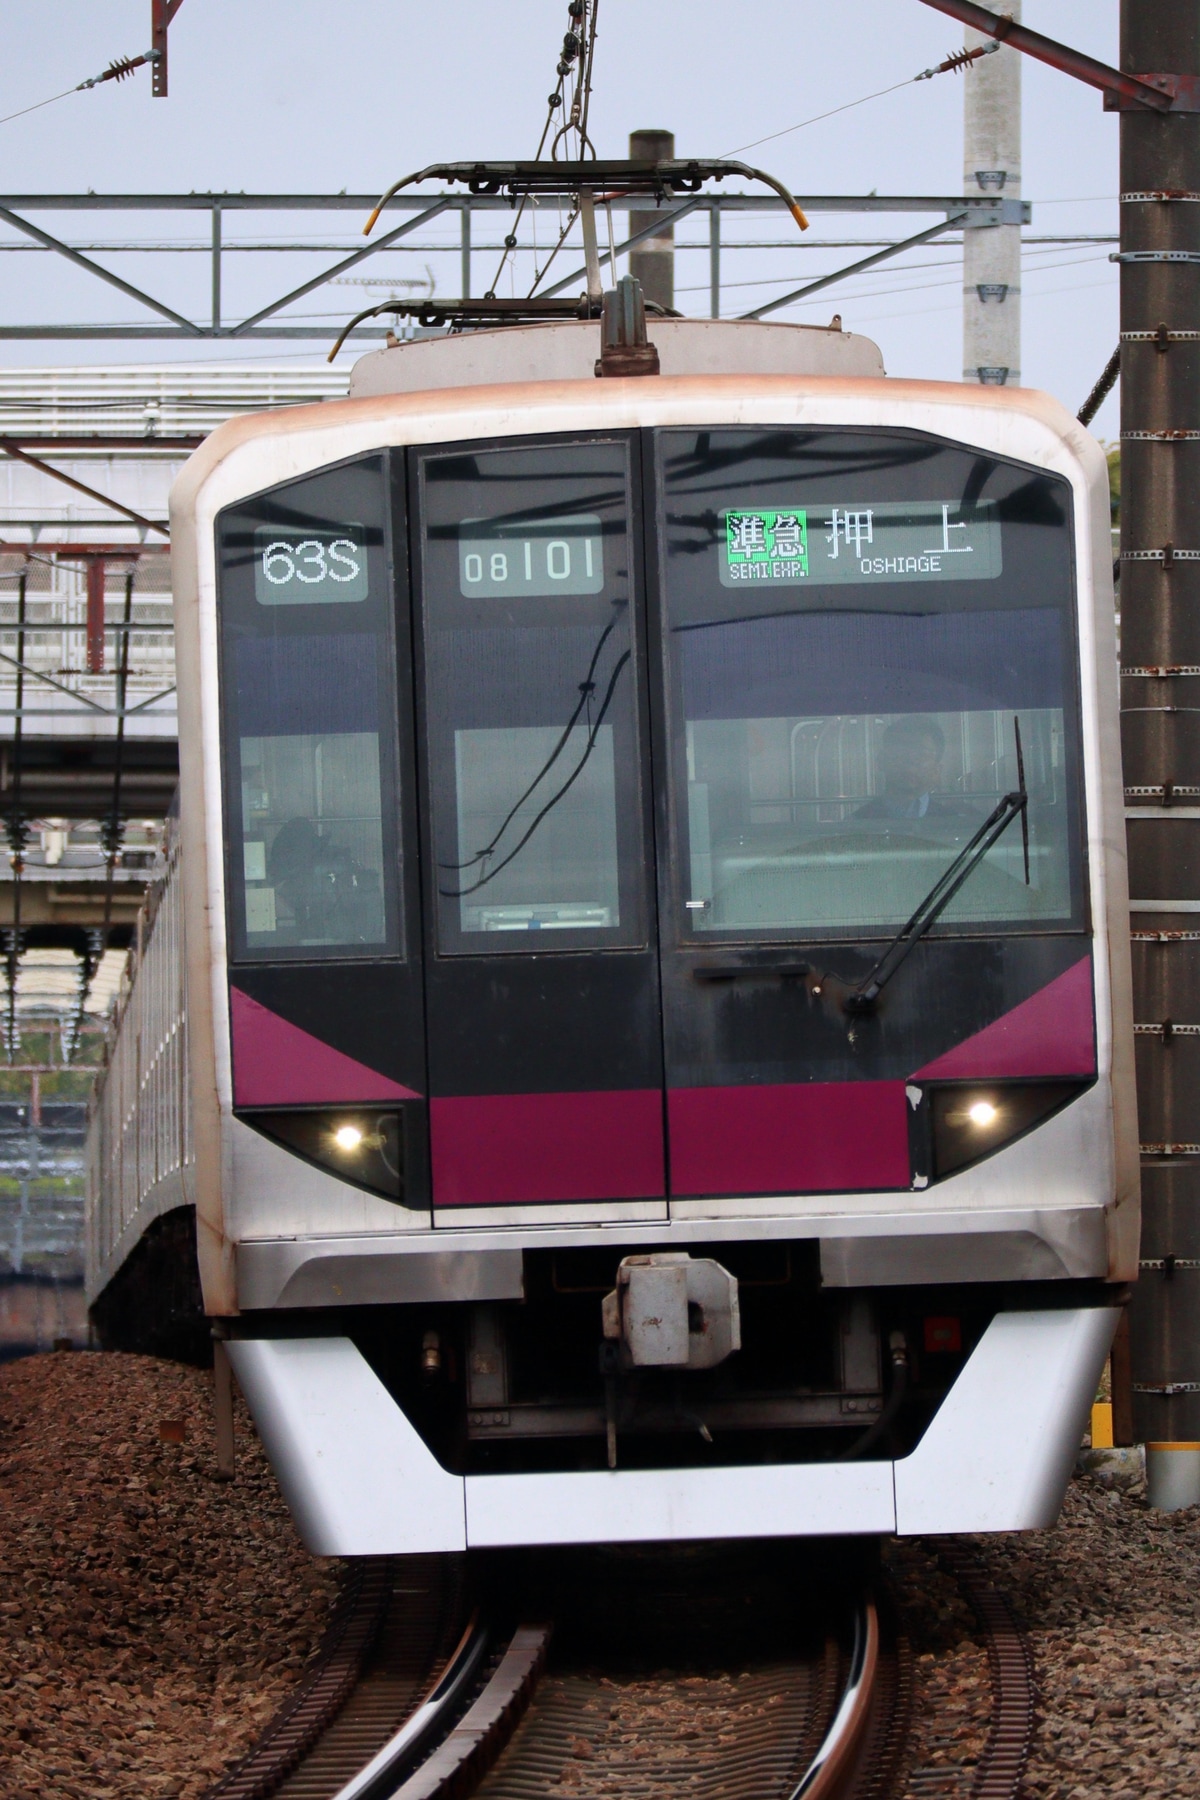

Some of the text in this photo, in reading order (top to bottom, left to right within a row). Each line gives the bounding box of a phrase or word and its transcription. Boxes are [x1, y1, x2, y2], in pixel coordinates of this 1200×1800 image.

[729, 514, 804, 558] 準急
[262, 540, 359, 585] 63S
[729, 561, 769, 579] SEMI
[860, 556, 942, 575] OSHIAGE
